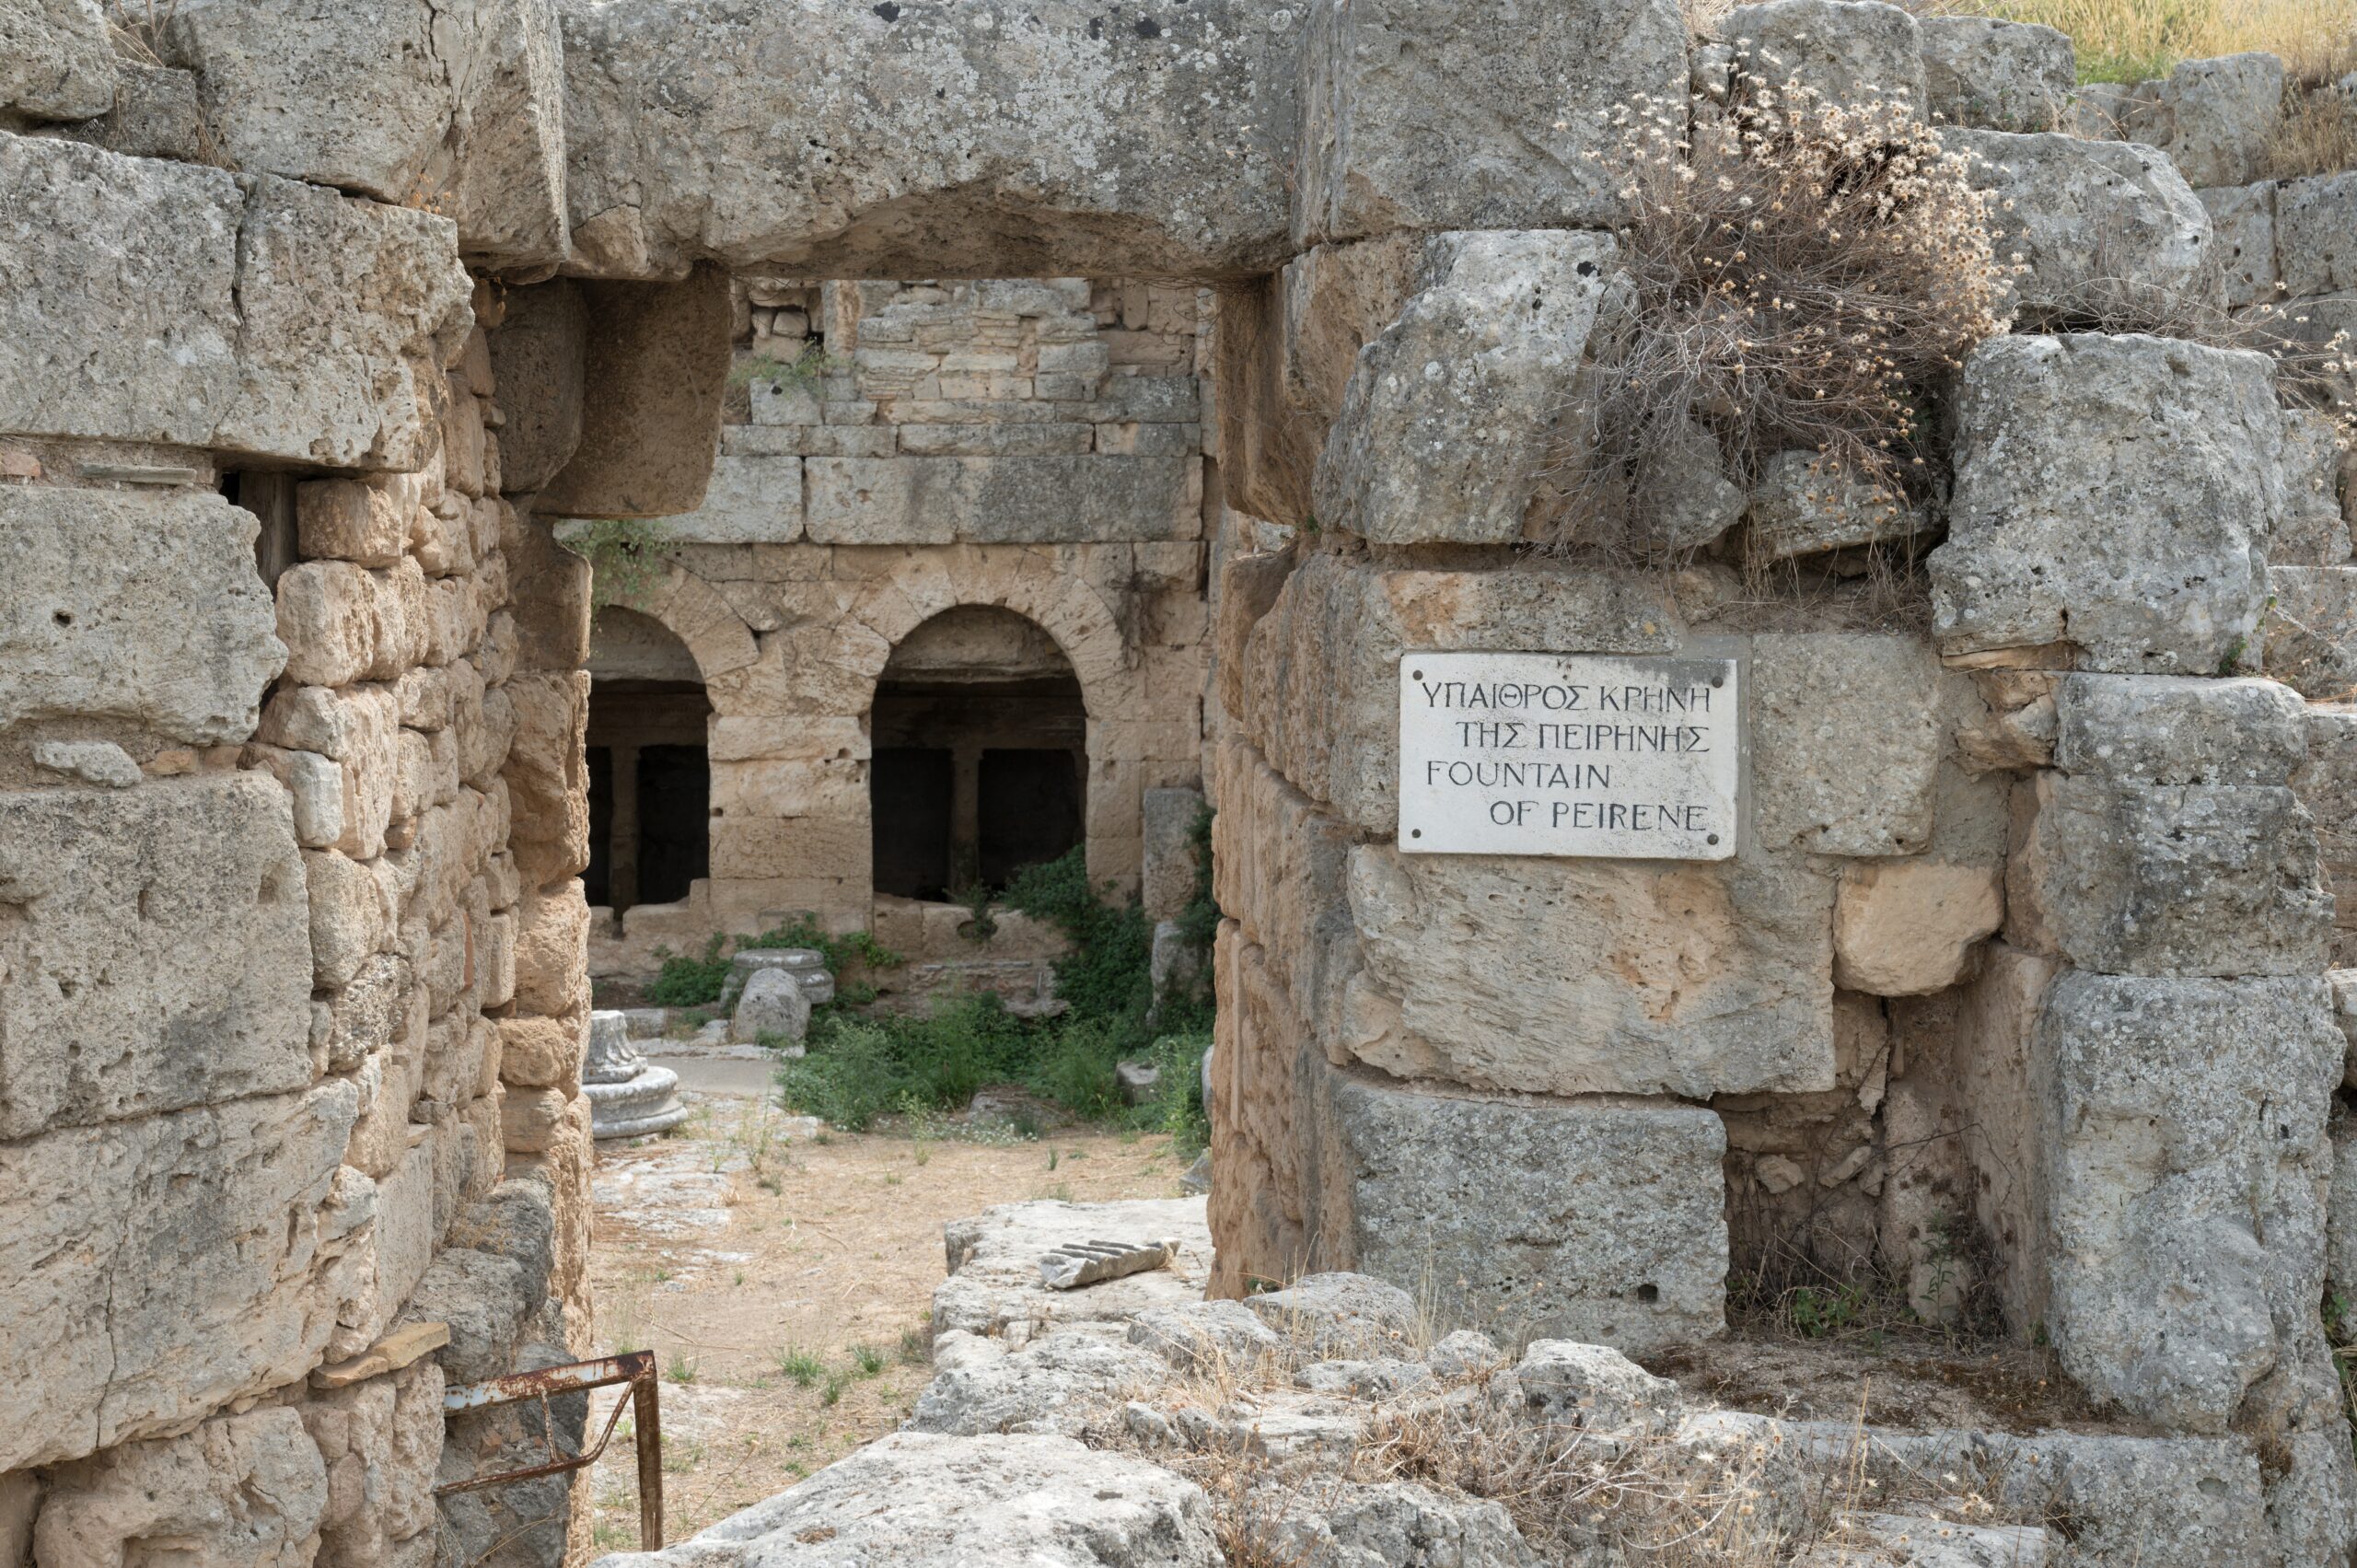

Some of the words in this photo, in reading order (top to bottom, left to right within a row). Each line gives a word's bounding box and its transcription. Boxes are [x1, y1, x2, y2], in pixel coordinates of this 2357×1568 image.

[1422, 681, 1589, 711] ΥΠΑΙΘΡΟΣ
[1599, 685, 1711, 713] ΚΡΗΝΗ
[1455, 721, 1527, 749] ΤΗΣ
[1538, 723, 1711, 752] ΠΕΙΡΗΝΗΣ
[1426, 760, 1610, 789] FOUNTAIN
[1490, 800, 1539, 827] OF
[1551, 801, 1709, 831] PEIRENE
